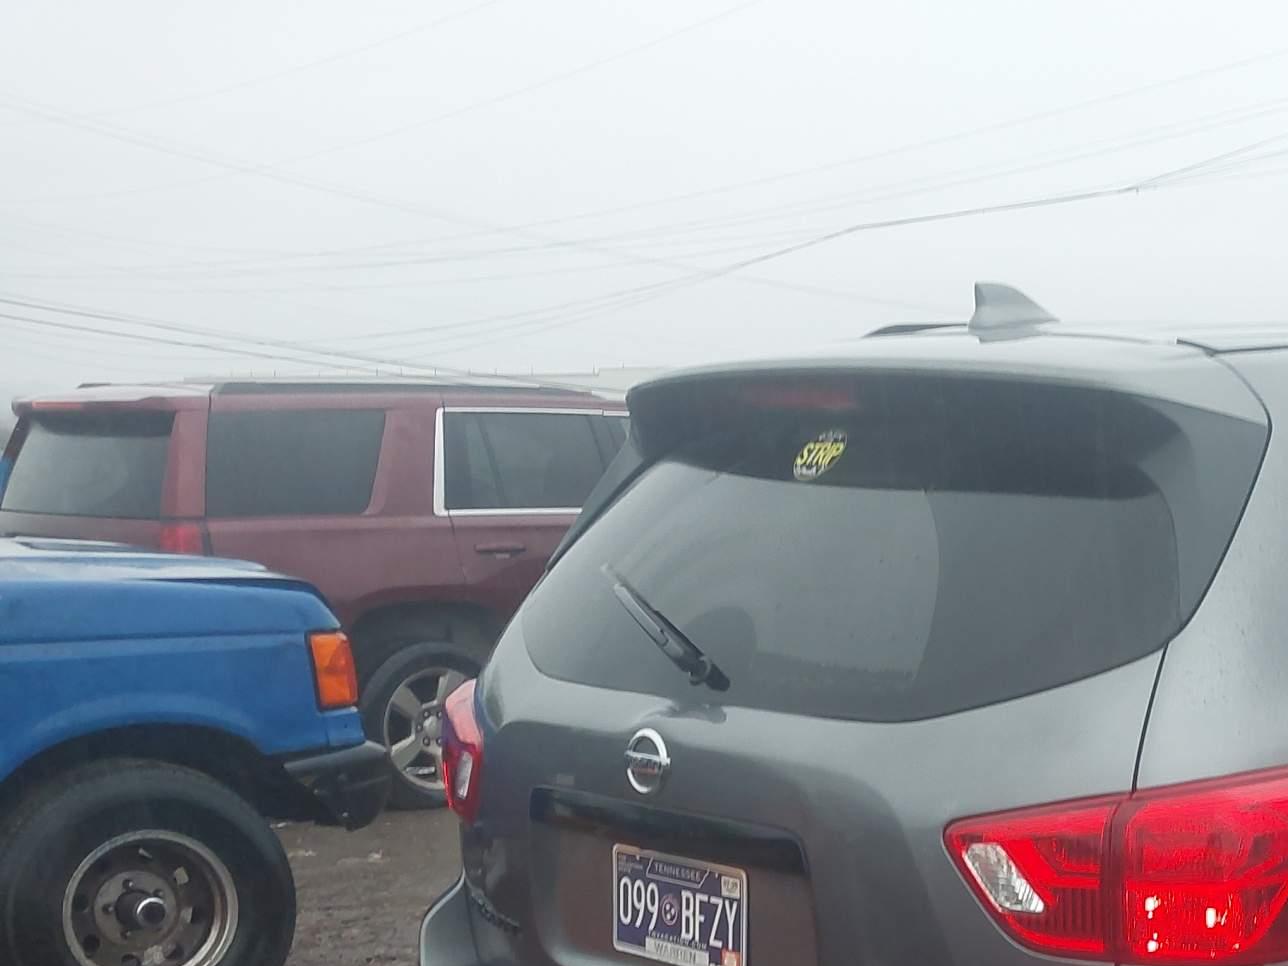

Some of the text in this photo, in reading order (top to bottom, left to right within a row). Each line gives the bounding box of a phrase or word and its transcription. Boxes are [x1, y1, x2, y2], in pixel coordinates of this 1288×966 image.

[654, 861, 701, 882] TENNESSEE
[619, 875, 738, 952] 099 BFZY
